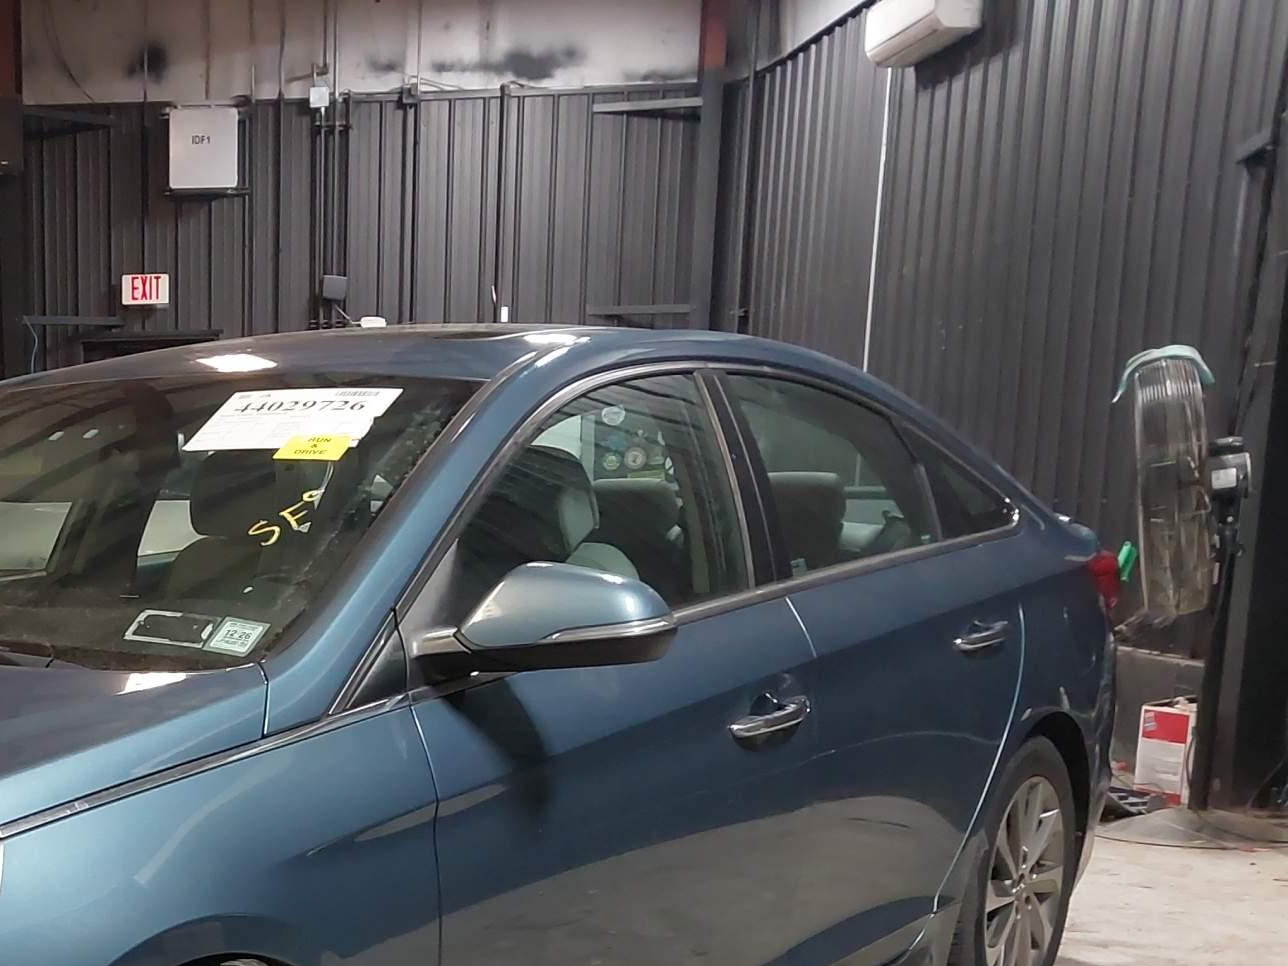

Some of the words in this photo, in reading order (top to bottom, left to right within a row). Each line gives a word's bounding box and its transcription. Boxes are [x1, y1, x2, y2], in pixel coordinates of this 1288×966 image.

[131, 275, 162, 300] EXIT
[235, 400, 366, 412] 44029726
[238, 631, 252, 639] 26
